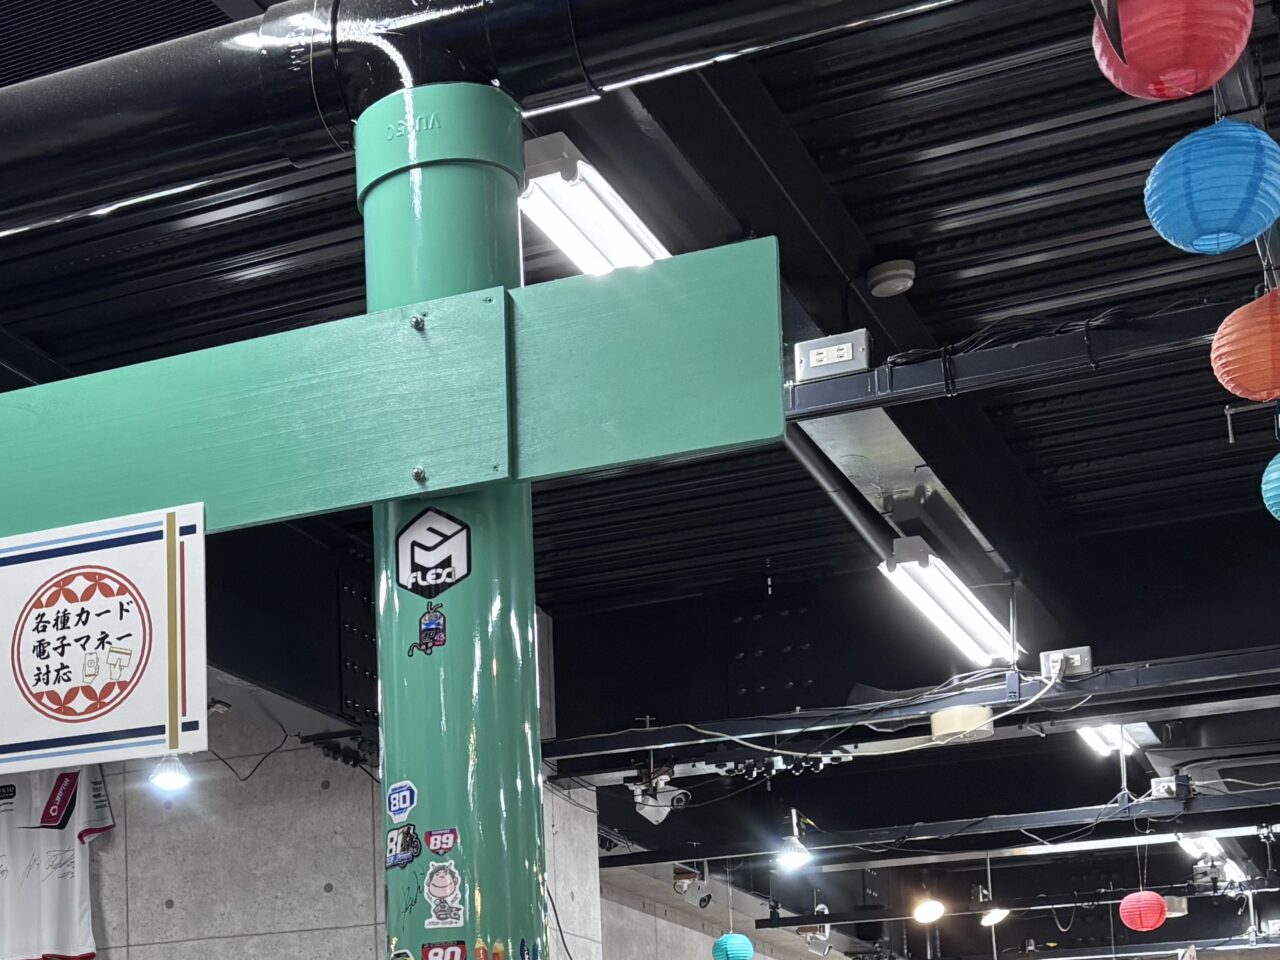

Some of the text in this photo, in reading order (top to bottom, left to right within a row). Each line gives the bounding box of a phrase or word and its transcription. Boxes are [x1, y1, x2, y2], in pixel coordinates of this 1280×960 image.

[32, 600, 133, 634] 各種カード
[32, 631, 133, 660] 電子マネー
[32, 663, 72, 687] 対応
[390, 790, 410, 812] 80
[429, 833, 454, 849] 89
